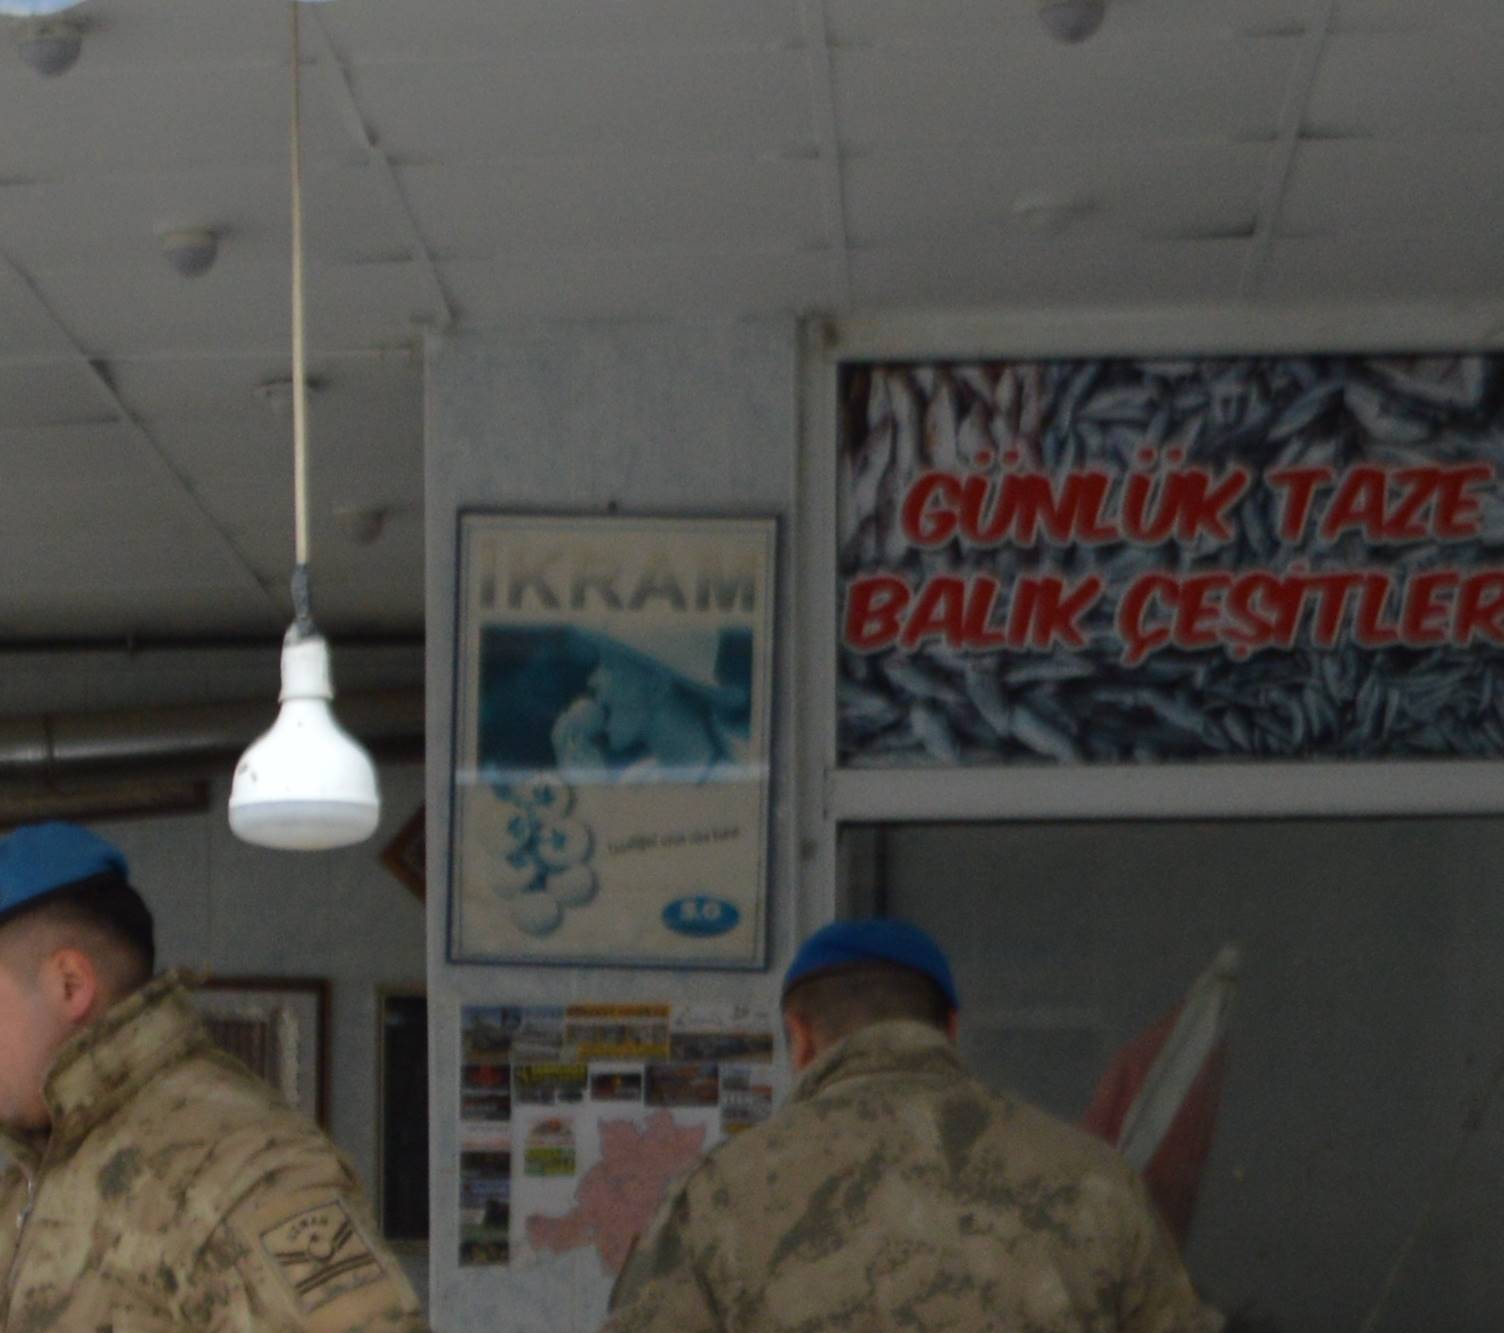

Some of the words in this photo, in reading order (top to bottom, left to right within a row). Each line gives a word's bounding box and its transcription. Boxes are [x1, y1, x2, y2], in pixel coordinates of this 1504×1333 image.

[901, 447, 1249, 546] GÜNLÜK
[1264, 462, 1495, 543] TAZE
[842, 571, 1102, 652] BALIK
